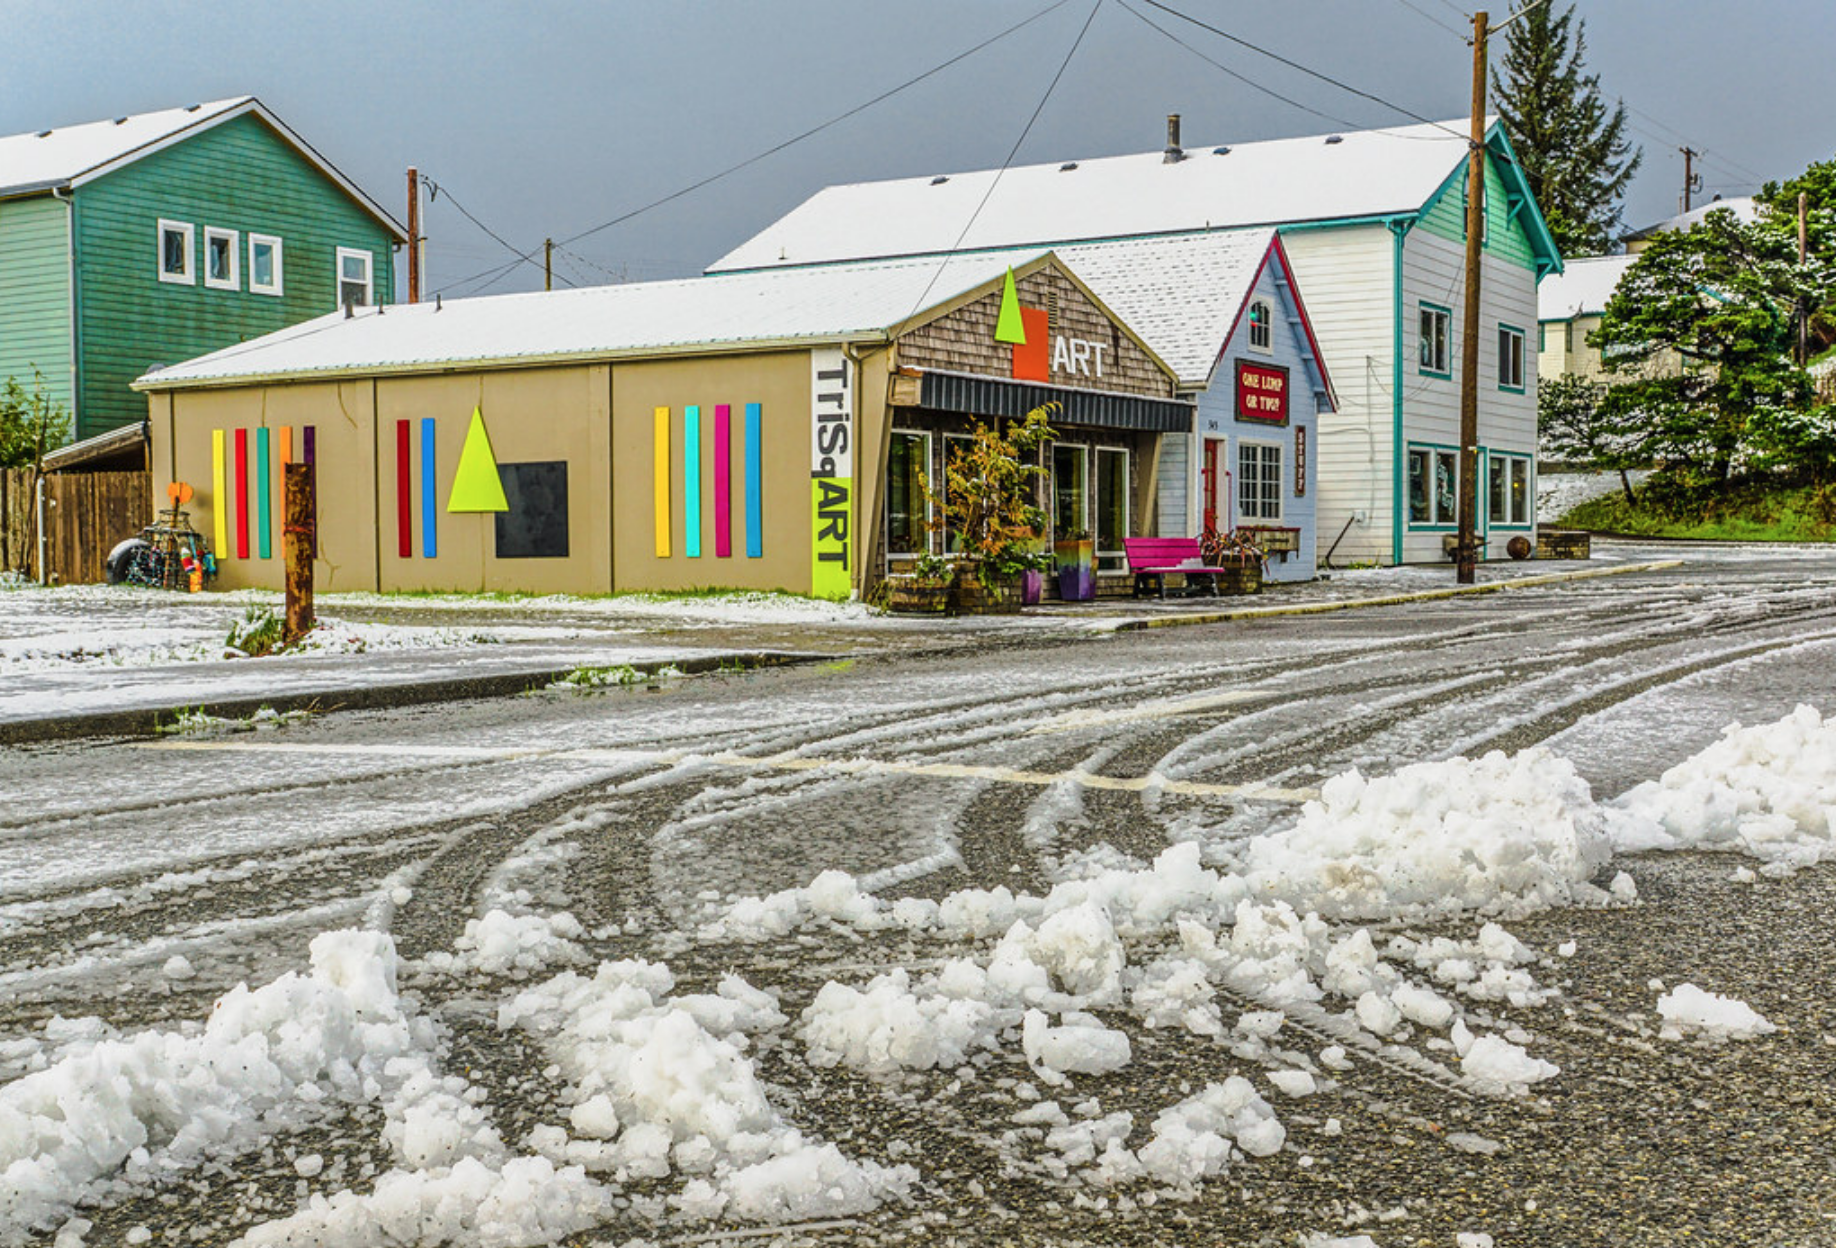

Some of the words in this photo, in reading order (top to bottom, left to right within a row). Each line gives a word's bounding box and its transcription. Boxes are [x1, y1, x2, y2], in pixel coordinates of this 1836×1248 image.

[1052, 334, 1108, 378] ART
[1242, 372, 1260, 388] ONE
[1261, 375, 1283, 392] LUMP
[1245, 394, 1258, 409] OR
